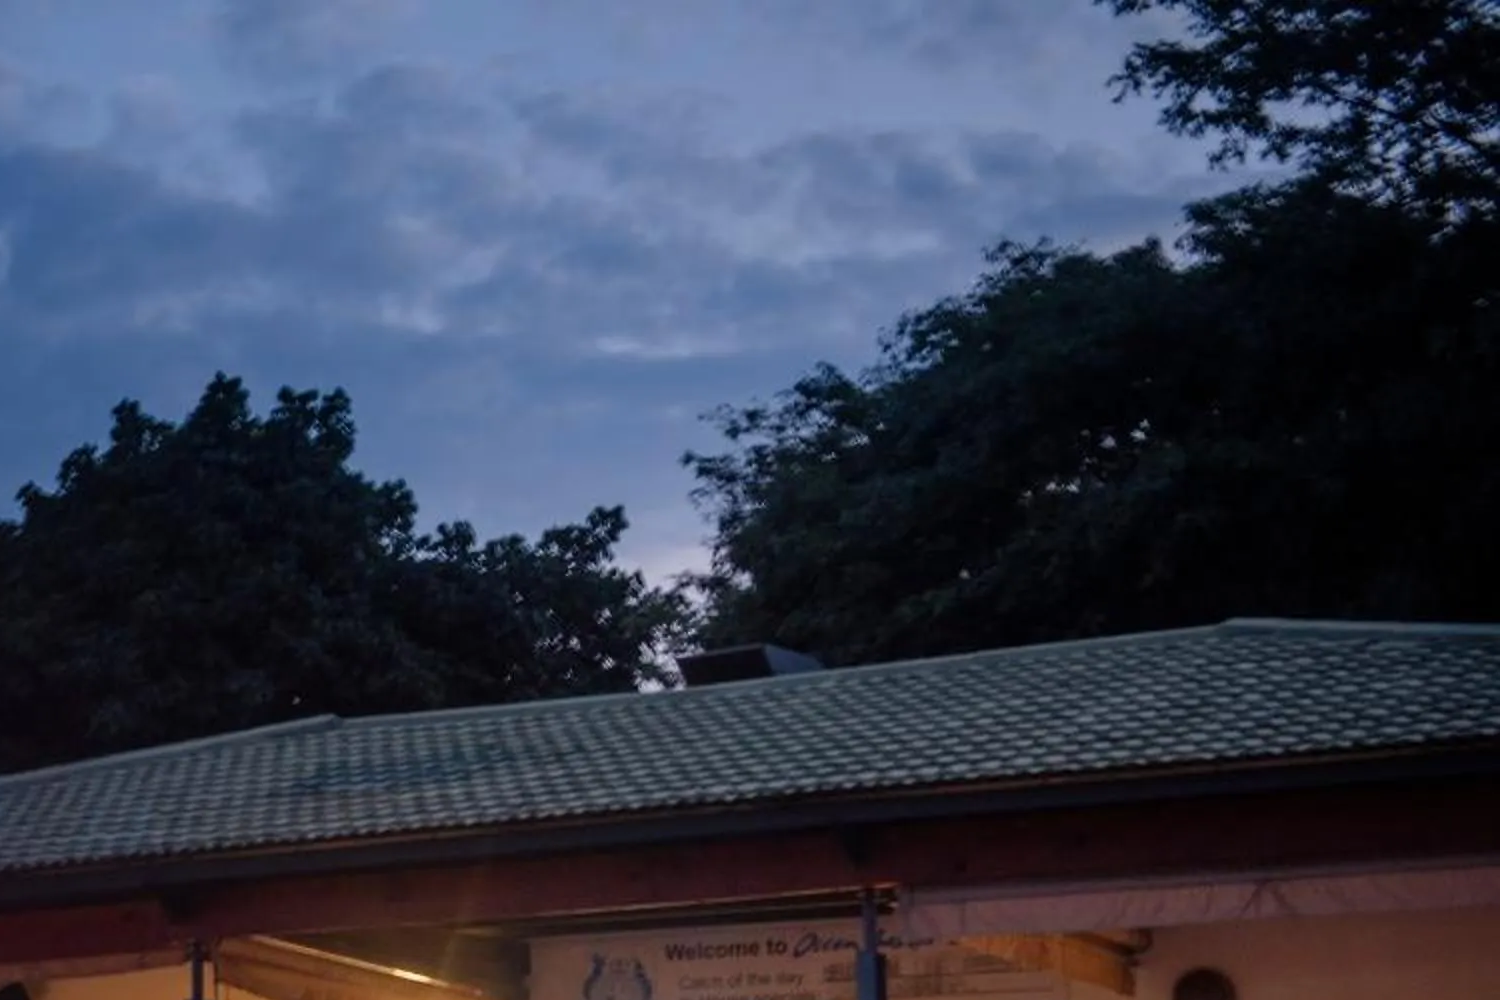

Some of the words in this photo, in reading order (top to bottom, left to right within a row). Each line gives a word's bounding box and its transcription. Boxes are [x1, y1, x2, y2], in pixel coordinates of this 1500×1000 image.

[665, 940, 759, 960] Welcome
[765, 938, 788, 956] to
[727, 972, 744, 988] of
[747, 971, 772, 986] the
[775, 972, 805, 988] day
